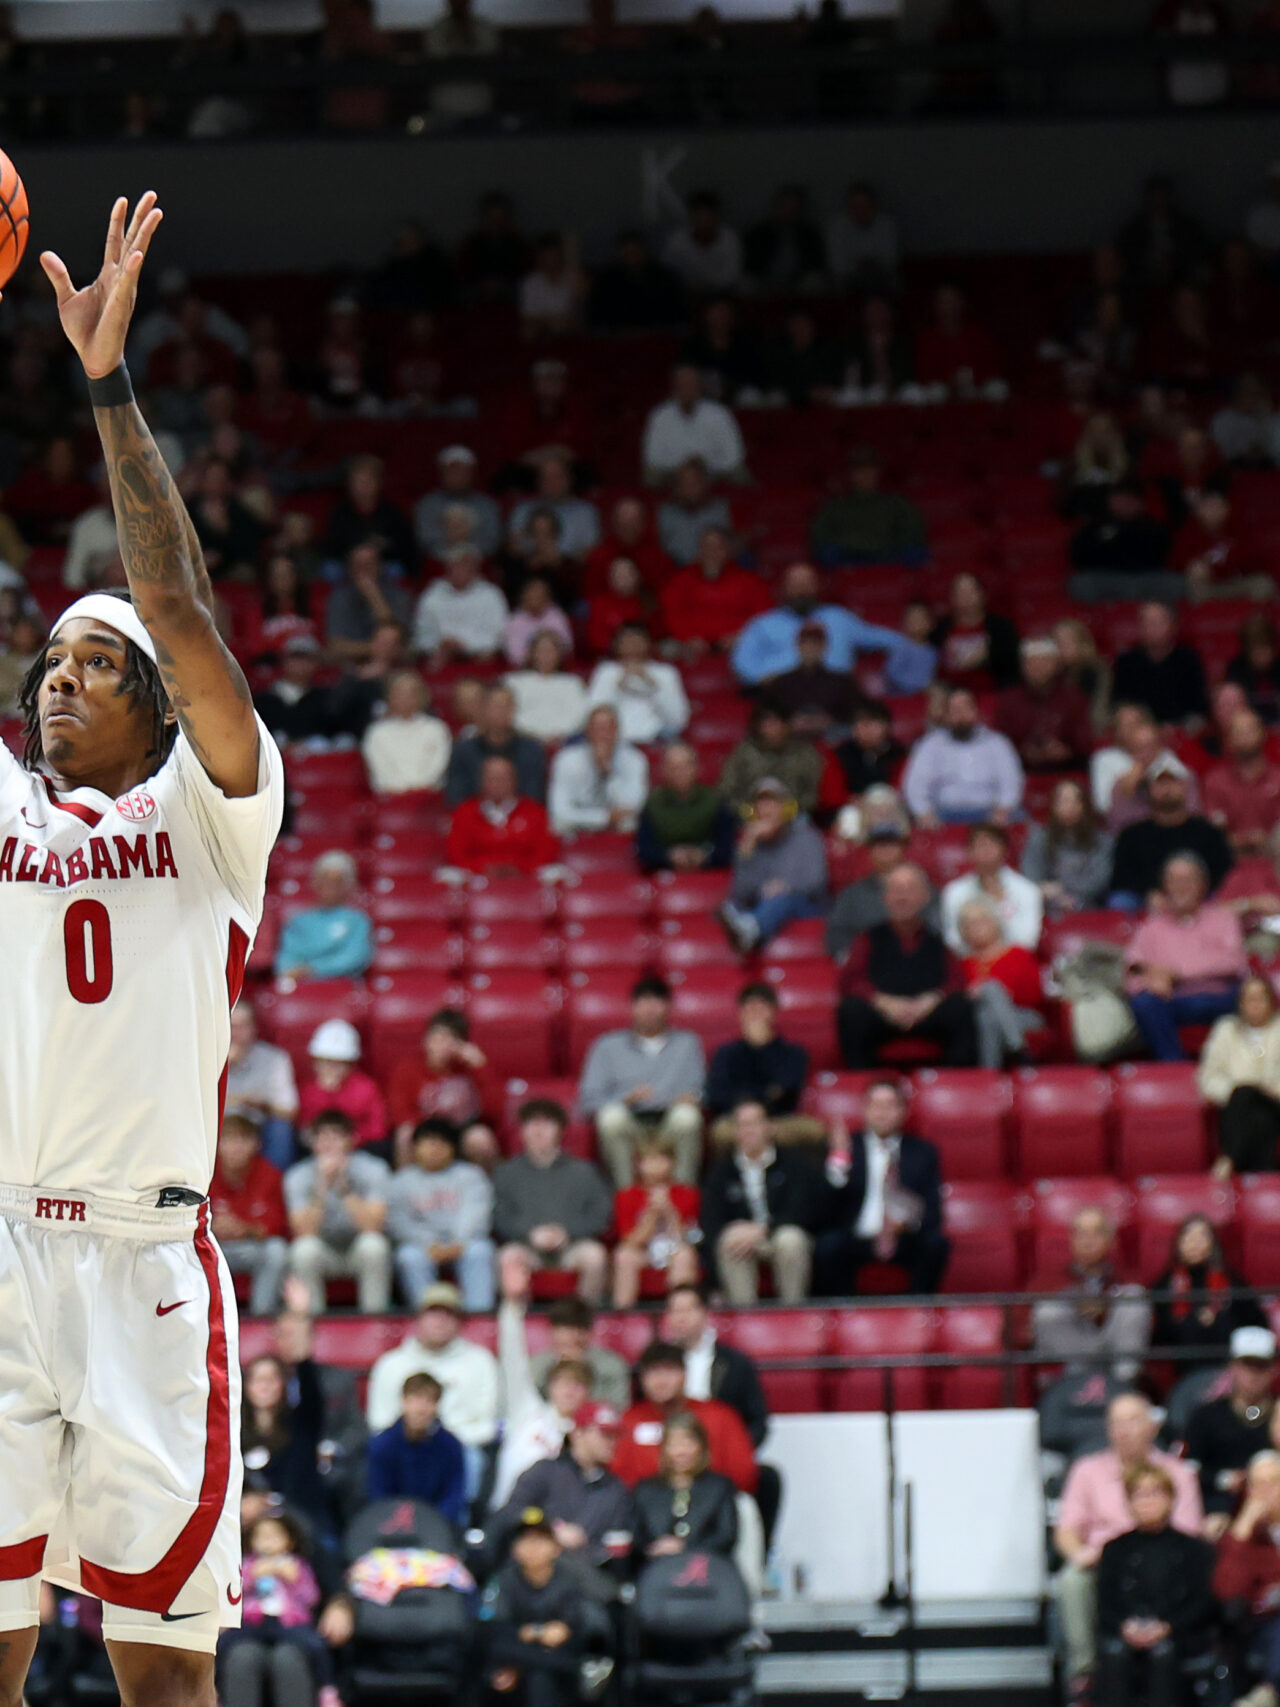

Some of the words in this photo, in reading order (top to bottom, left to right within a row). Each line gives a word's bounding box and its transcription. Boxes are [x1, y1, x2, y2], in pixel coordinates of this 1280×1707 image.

[117, 795, 155, 819] SEC
[63, 898, 113, 1004] 0
[35, 1197, 86, 1222] RTR
